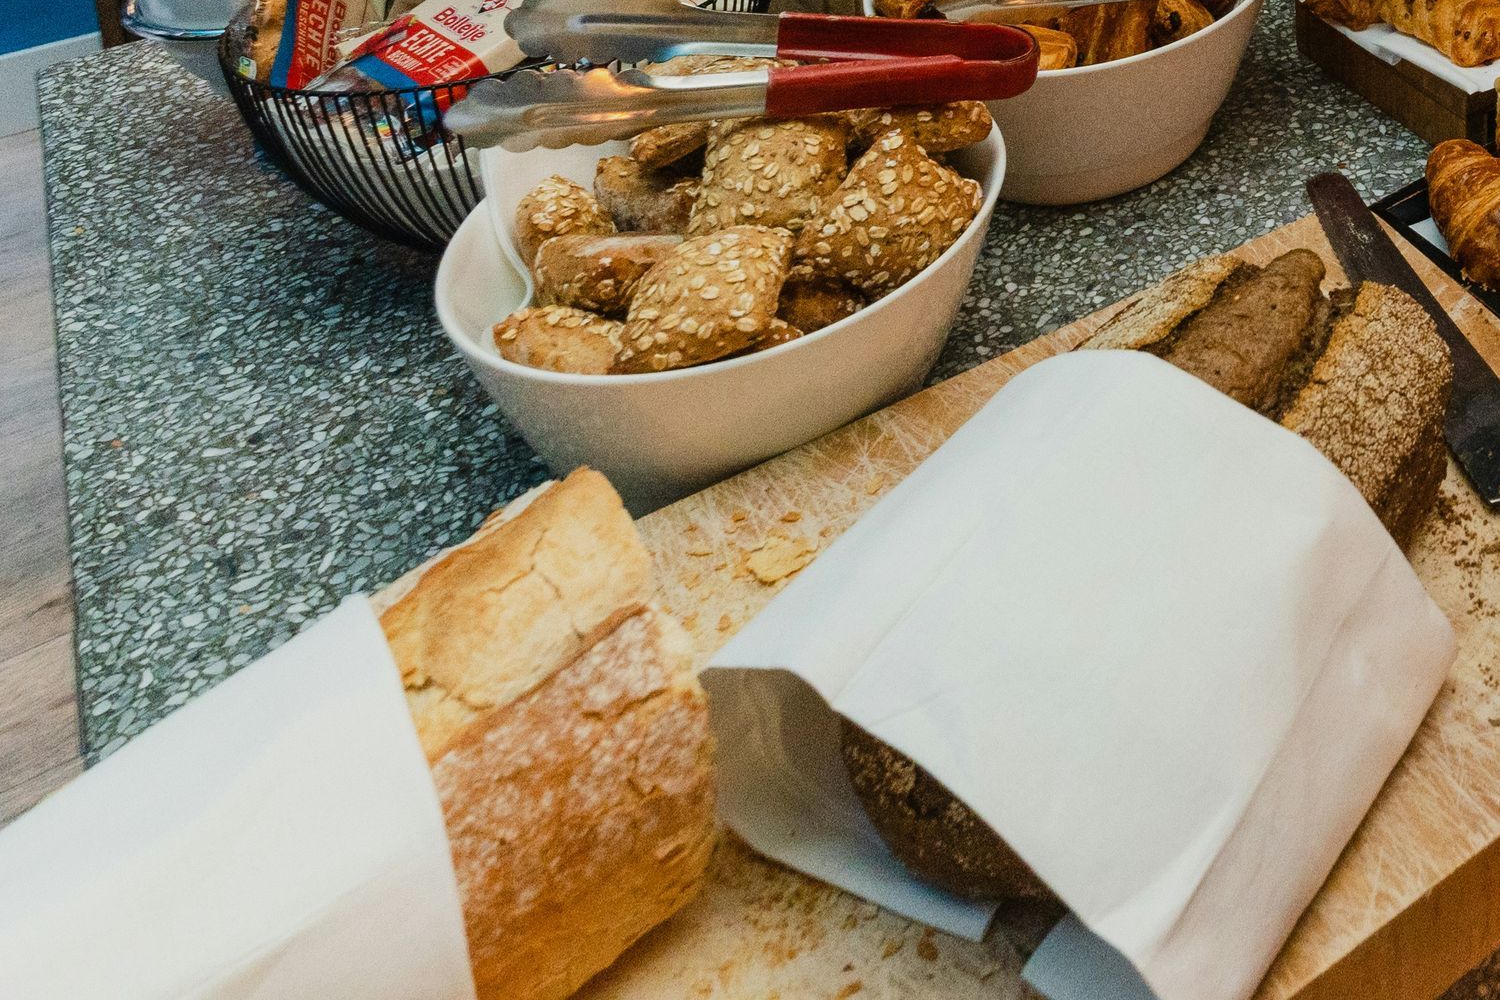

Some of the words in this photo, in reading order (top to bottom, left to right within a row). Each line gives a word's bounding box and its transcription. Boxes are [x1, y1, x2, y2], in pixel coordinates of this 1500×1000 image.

[297, 1, 310, 53] BESCHUIT
[432, 7, 487, 42] Bolletje
[400, 28, 456, 63] ECHTE
